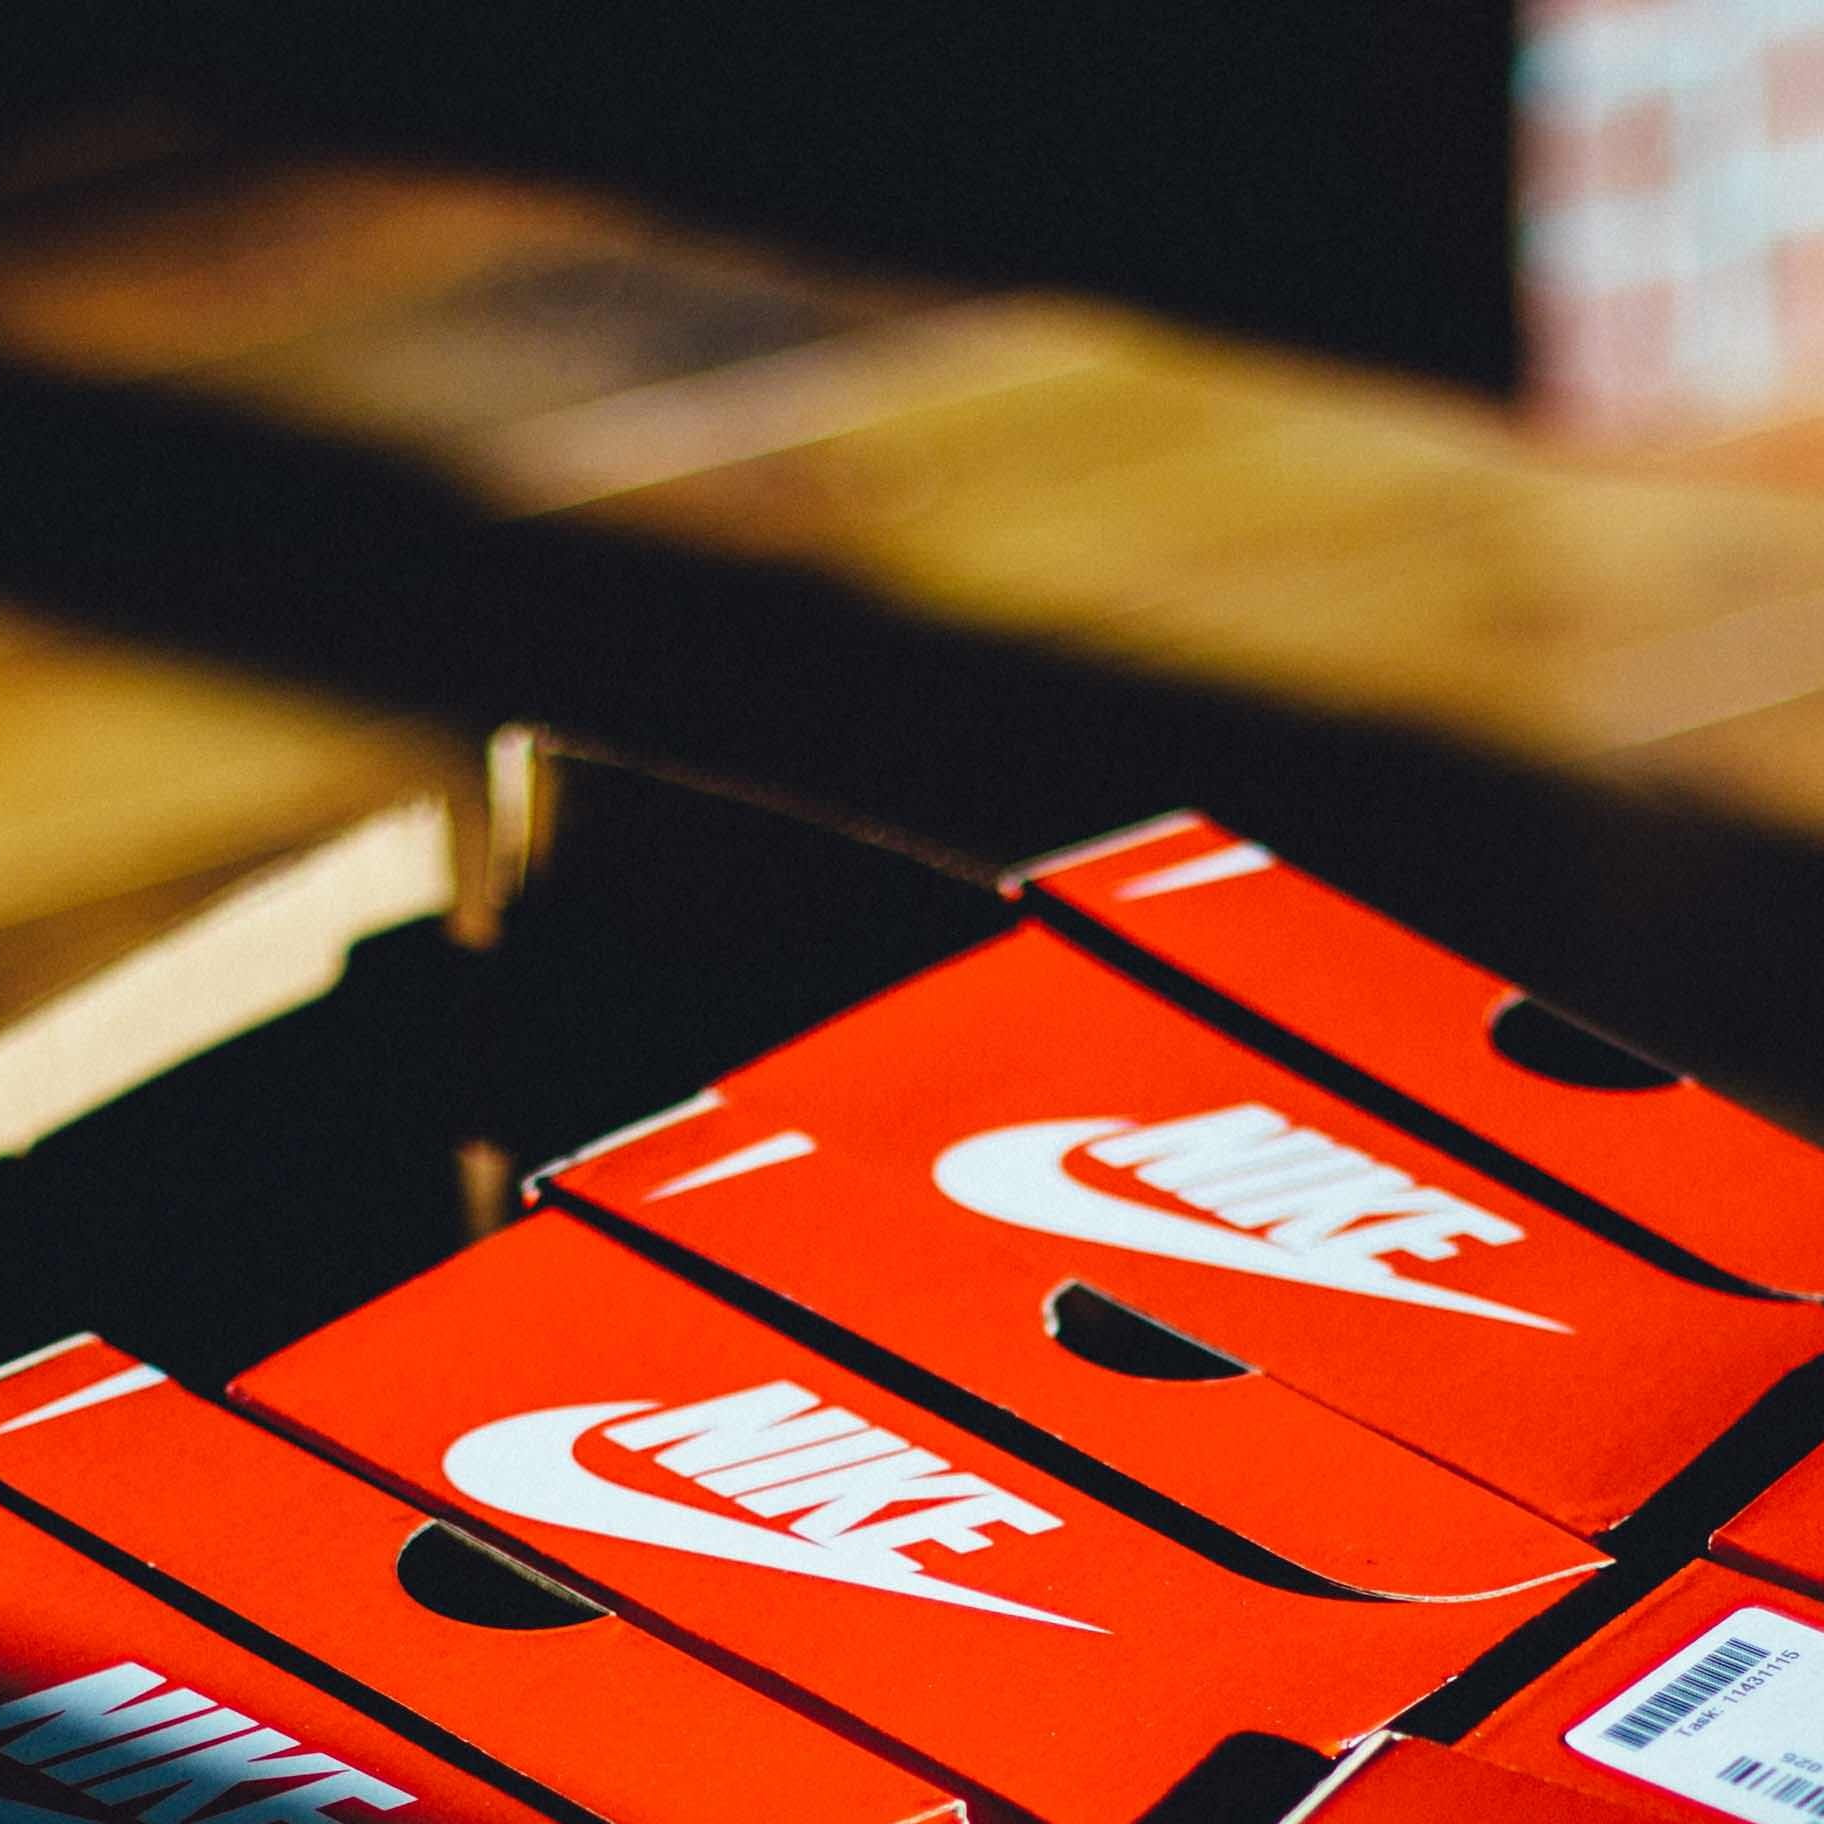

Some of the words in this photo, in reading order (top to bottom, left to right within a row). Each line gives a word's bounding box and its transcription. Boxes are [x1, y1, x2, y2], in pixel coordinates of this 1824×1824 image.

[1084, 1103, 1526, 1276] NIKE
[602, 1380, 1064, 1572] NIKE
[1675, 1702, 1725, 1738] Task:
[1722, 1648, 1800, 1705] 11431115
